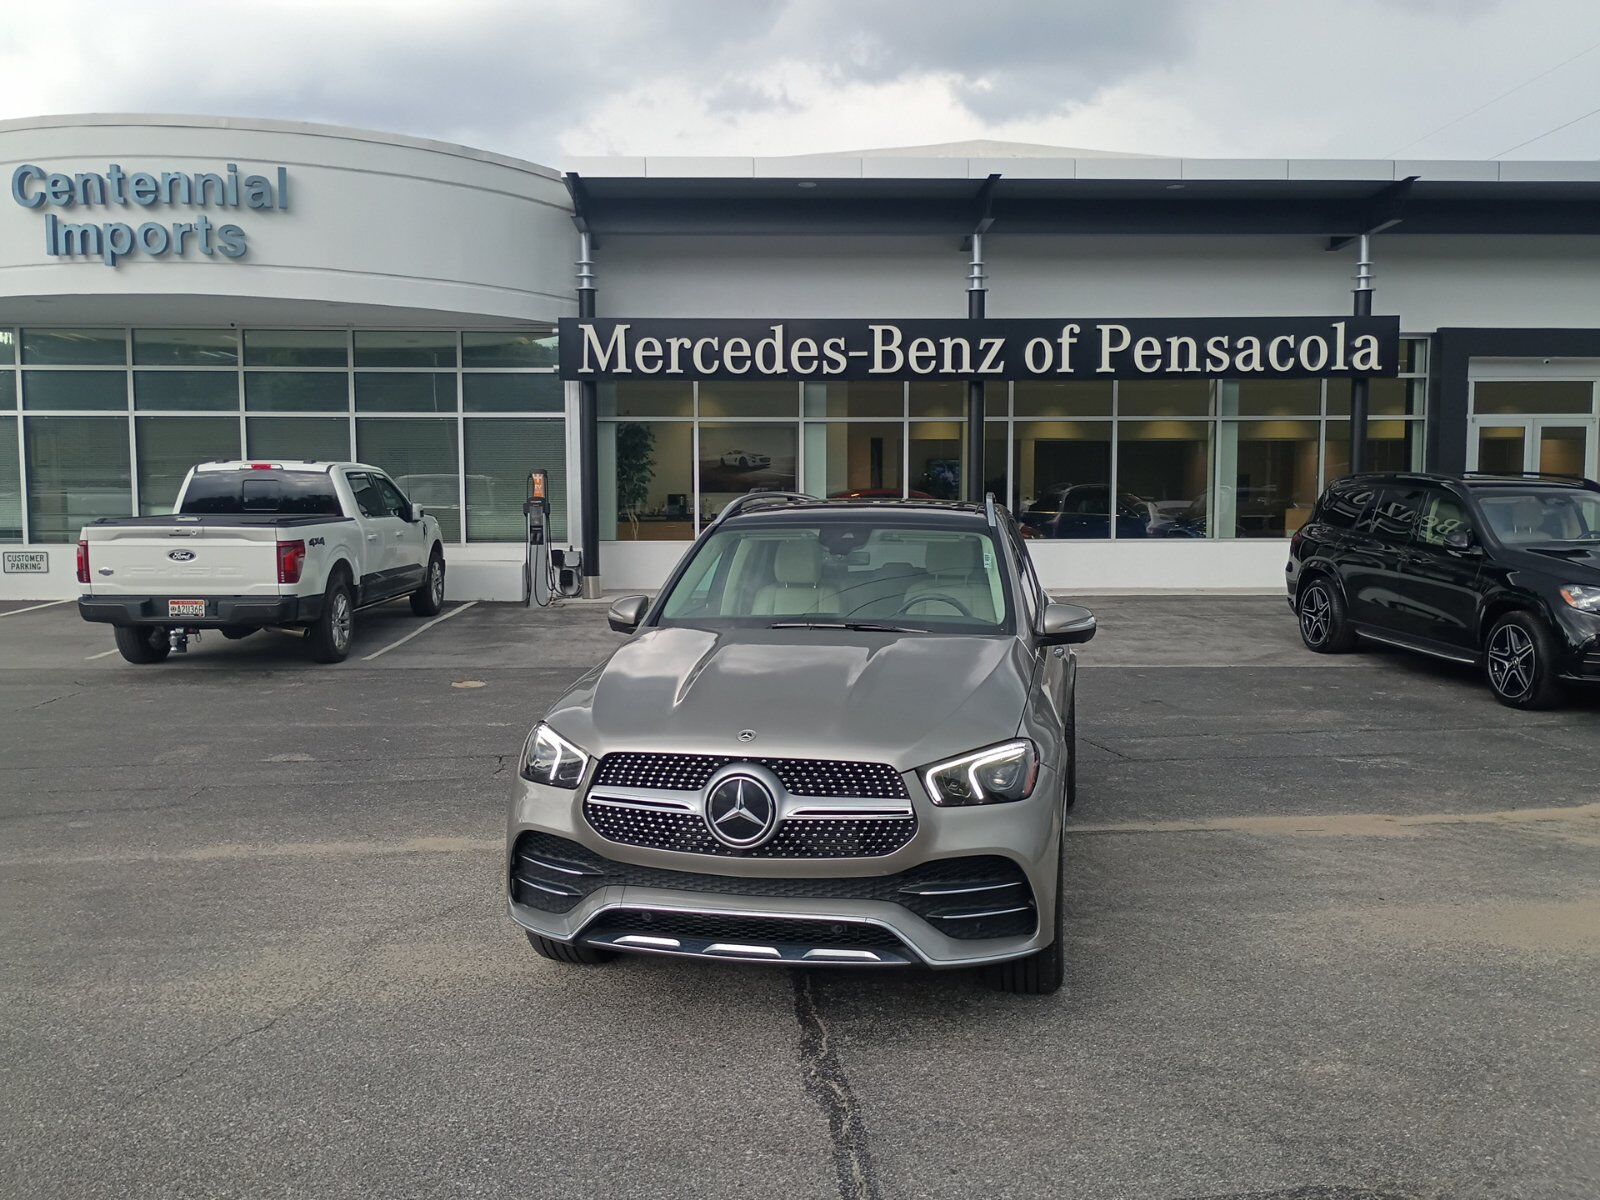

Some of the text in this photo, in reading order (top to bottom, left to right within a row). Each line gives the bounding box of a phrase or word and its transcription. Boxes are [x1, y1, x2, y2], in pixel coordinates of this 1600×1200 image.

[12, 164, 288, 209] Centennial
[45, 214, 248, 266] Imports
[578, 321, 1382, 375] Mercedes-Benz of Pensacola
[7, 554, 45, 562] CUSTOMER
[11, 562, 41, 570] PARKING
